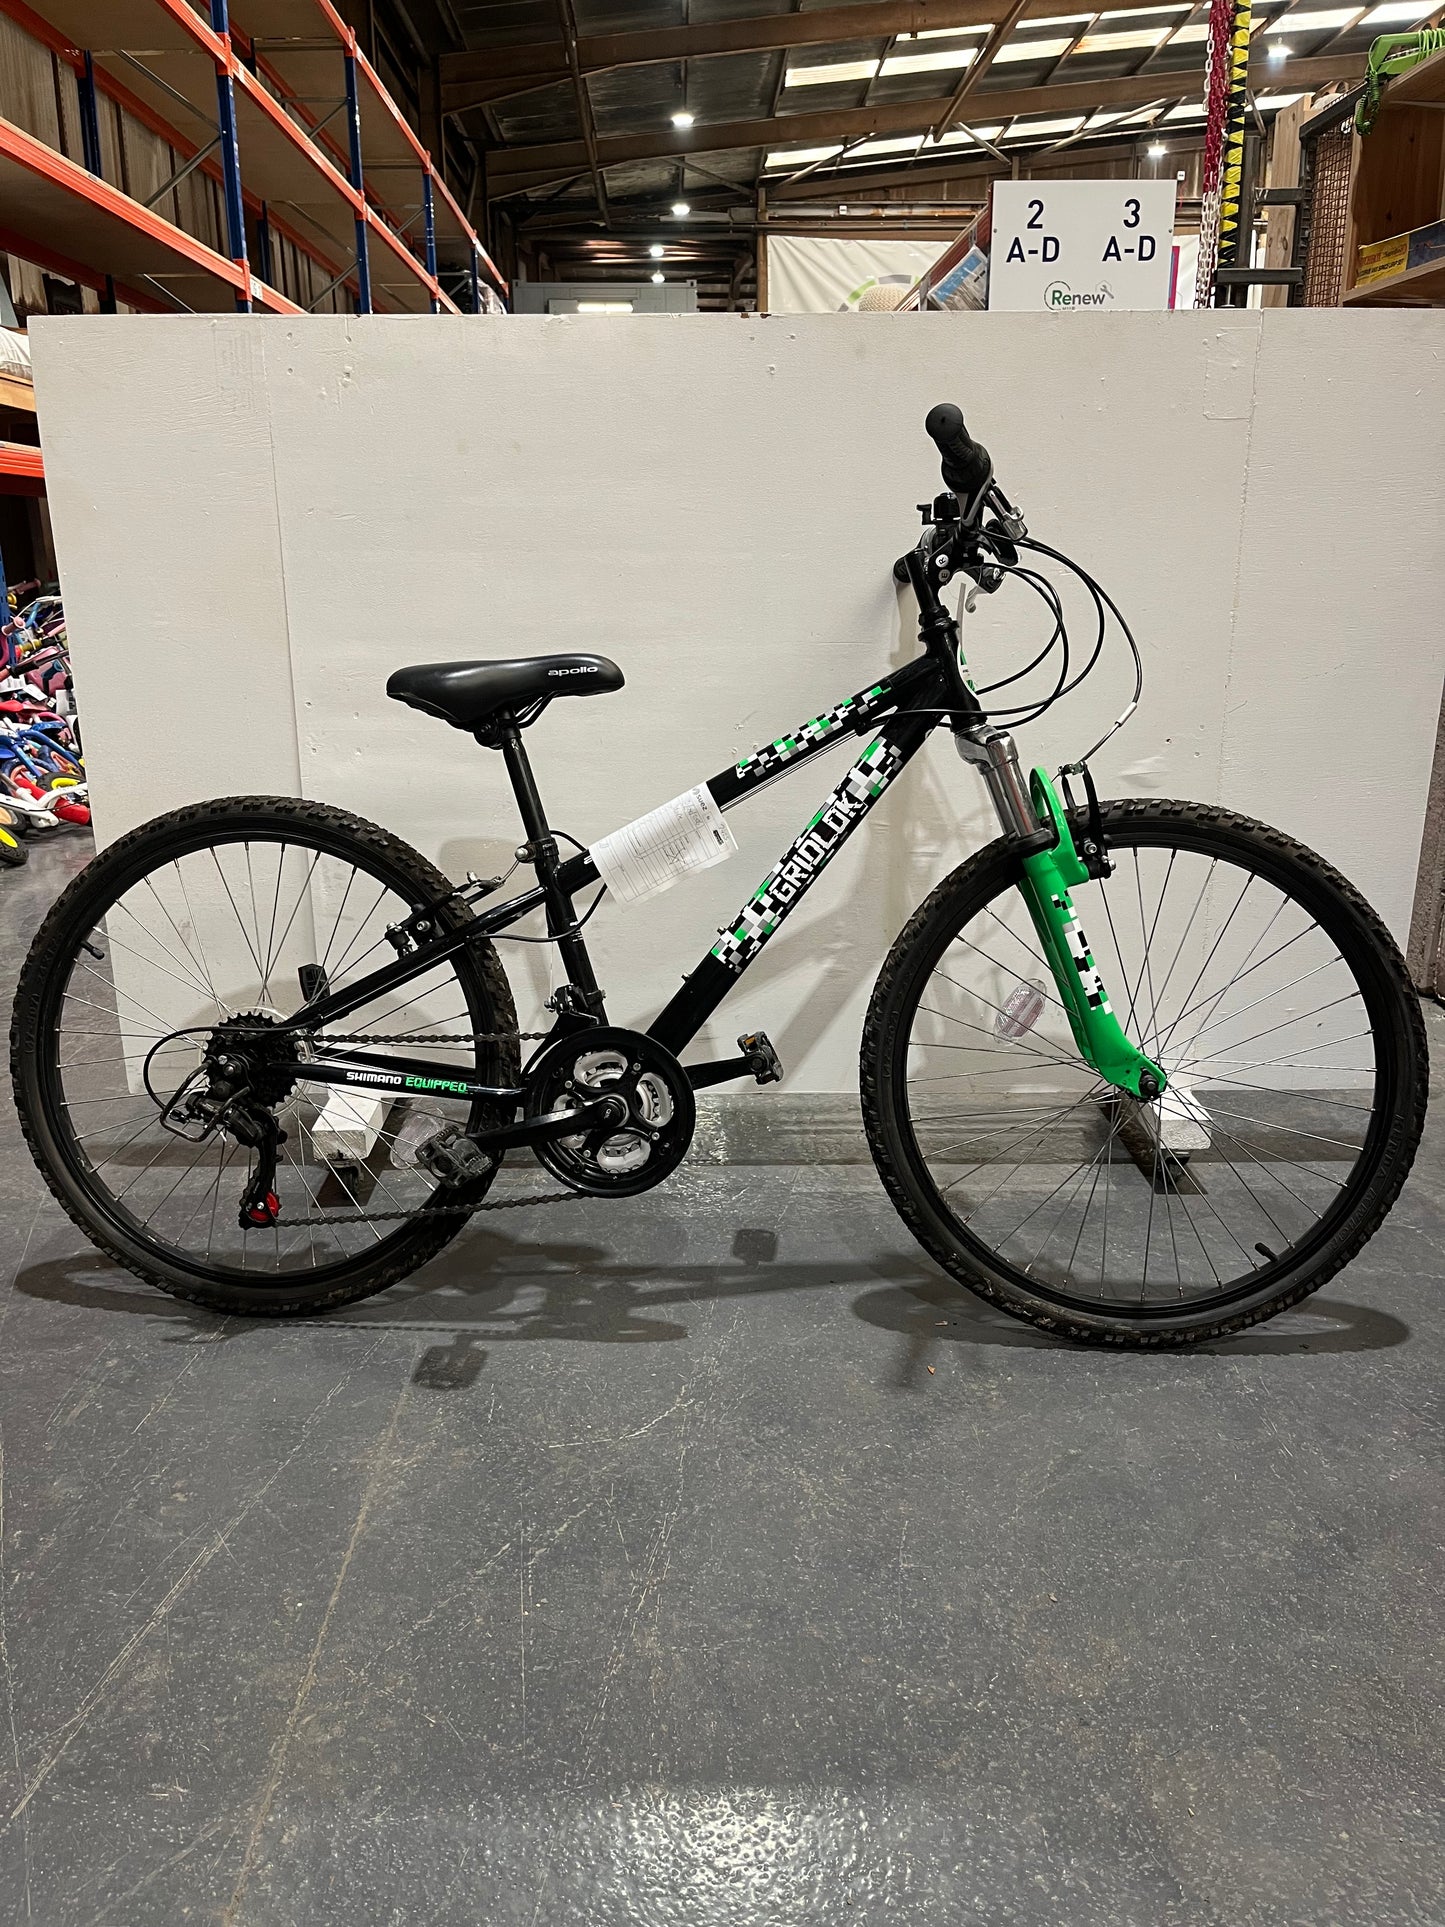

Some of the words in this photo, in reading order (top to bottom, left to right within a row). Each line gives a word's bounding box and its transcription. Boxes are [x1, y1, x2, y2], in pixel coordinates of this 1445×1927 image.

[1027, 199, 1044, 229] 2
[1123, 198, 1141, 228] 3
[1006, 236, 1060, 263] A-D
[1102, 235, 1156, 262] A-D
[1052, 289, 1105, 306] Renew
[547, 666, 599, 677] apollo
[696, 794, 708, 812] suez
[768, 790, 864, 904] GRIDLOK
[346, 1071, 402, 1085] SHIMANO
[405, 1076, 468, 1094] EQUIPPED
[1376, 1113, 1405, 1181] KENDA
